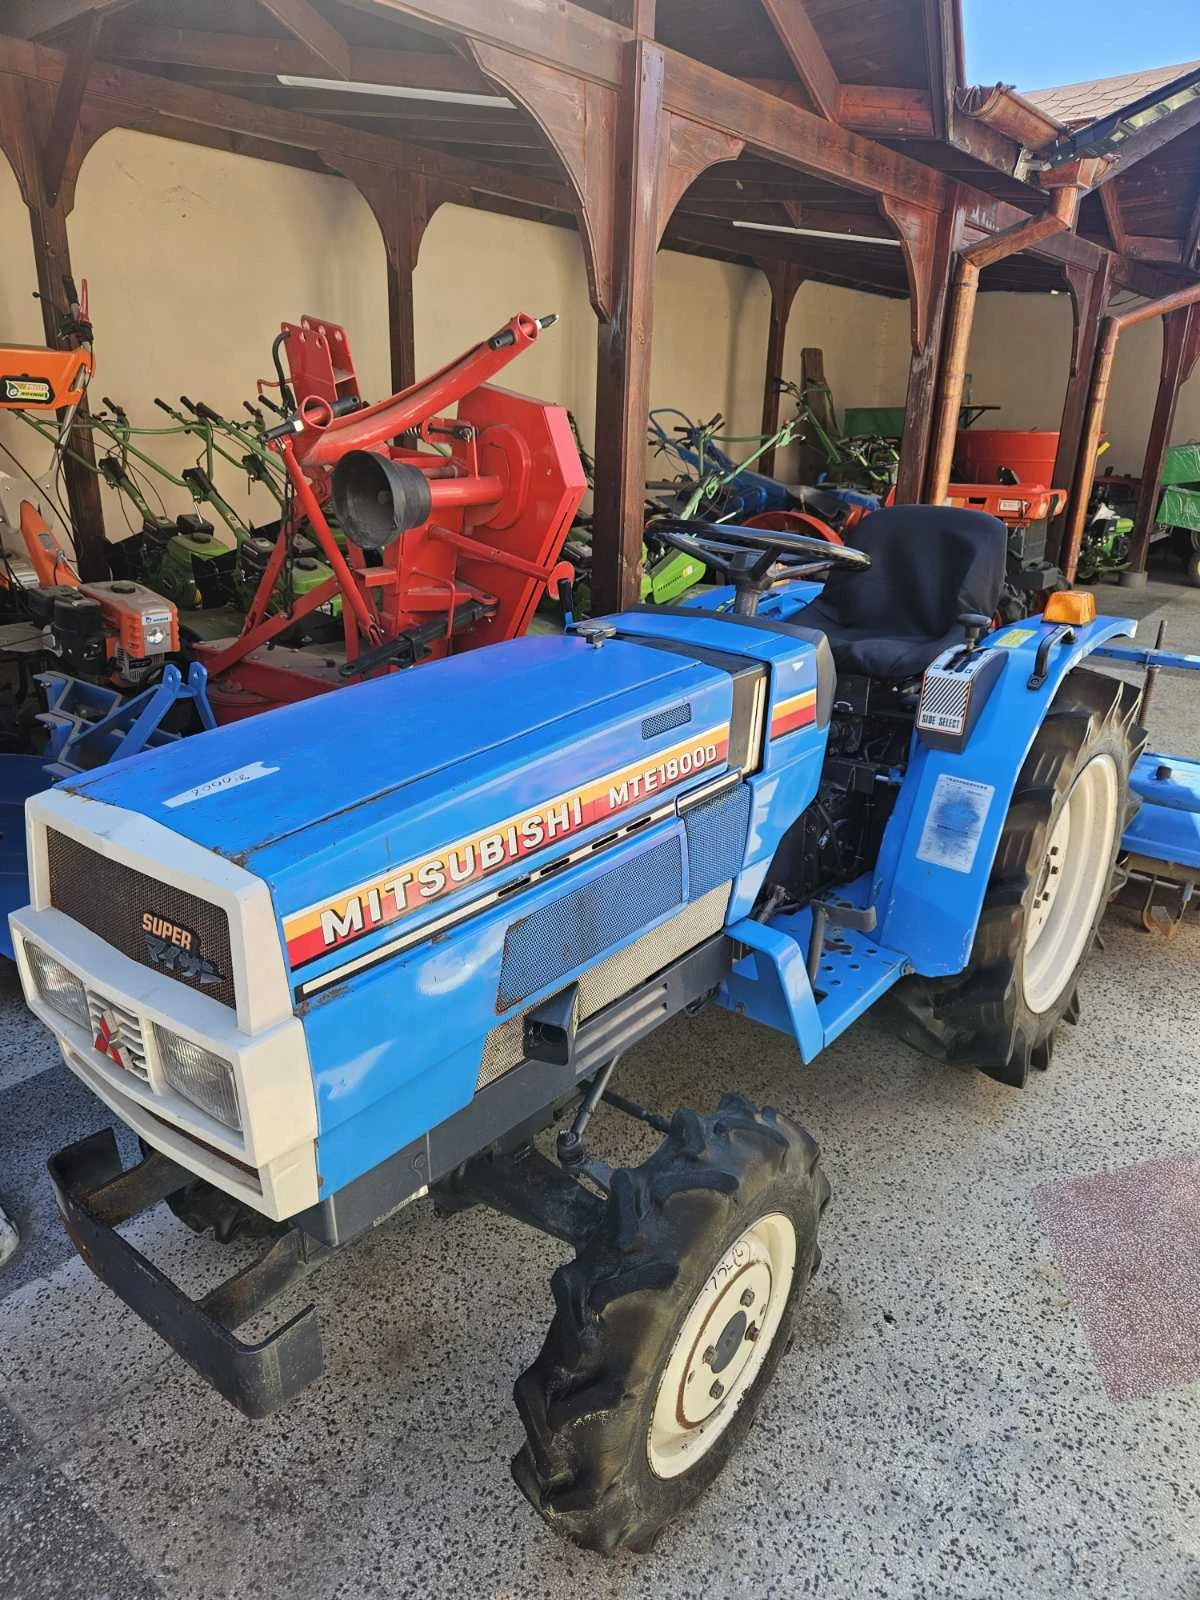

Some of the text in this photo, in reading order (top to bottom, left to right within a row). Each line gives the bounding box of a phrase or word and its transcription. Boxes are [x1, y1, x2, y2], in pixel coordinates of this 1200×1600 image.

[921, 714, 961, 729] SIDE SELECT
[608, 744, 718, 809] MTE1800D
[320, 796, 584, 945] MITSUBISHI
[142, 912, 192, 951] SUPER
